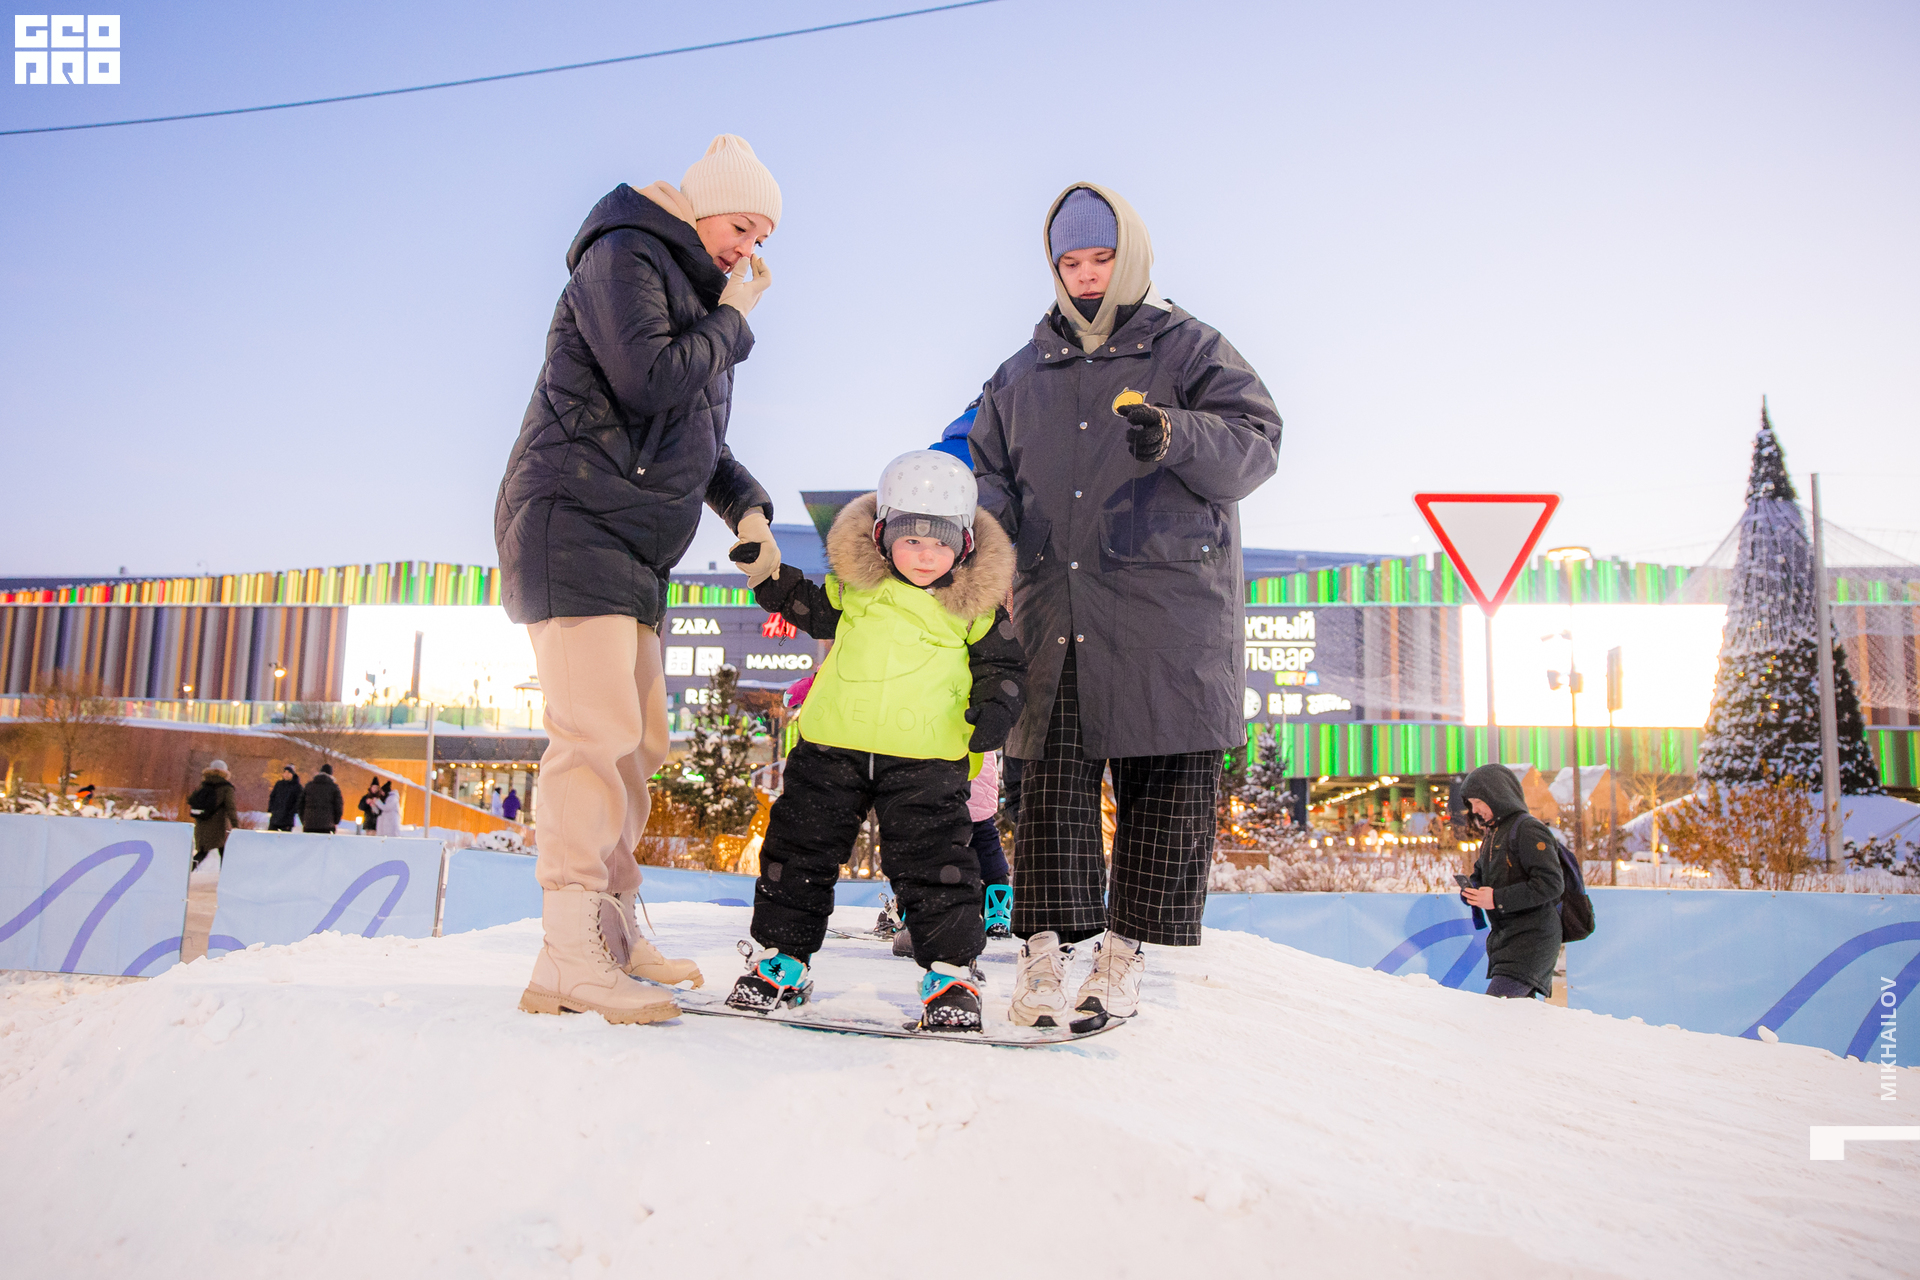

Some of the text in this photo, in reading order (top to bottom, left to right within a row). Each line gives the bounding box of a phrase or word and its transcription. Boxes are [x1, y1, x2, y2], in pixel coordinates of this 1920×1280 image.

[671, 618, 721, 635] ZARA
[746, 654, 813, 670] MANGO
[813, 696, 938, 740] SNEJOK
